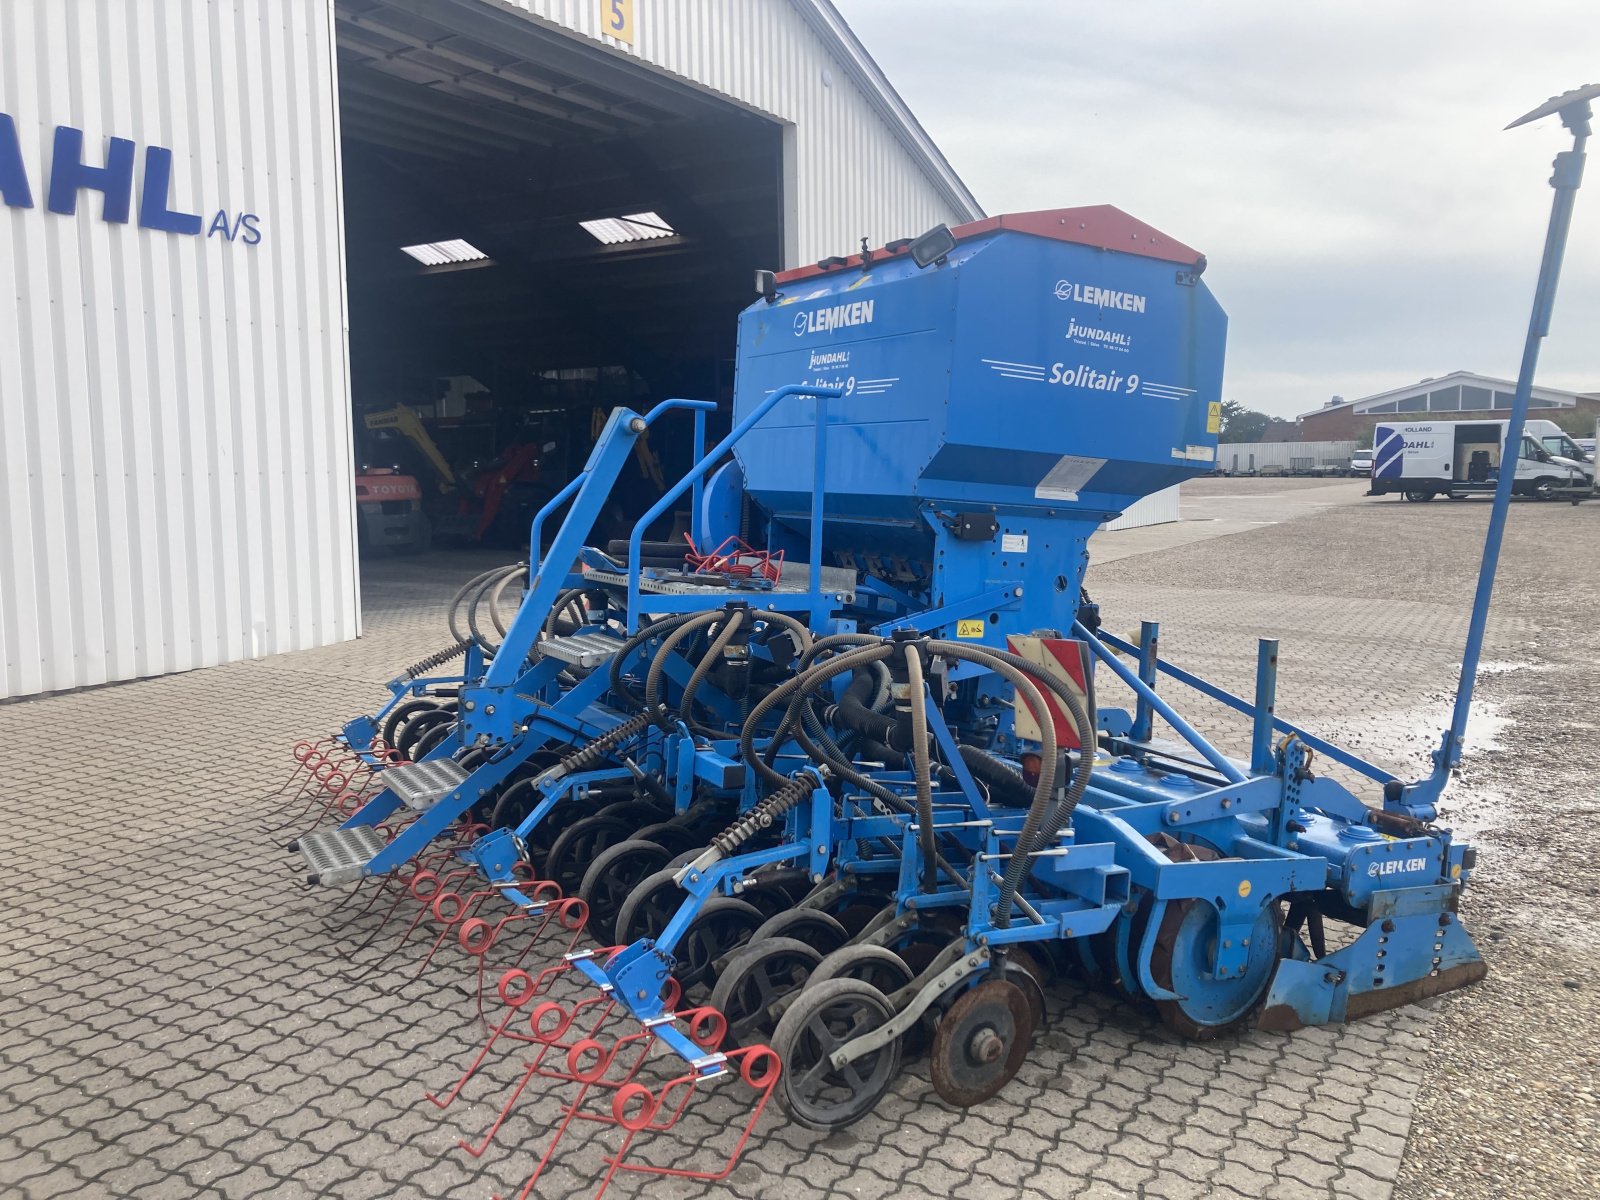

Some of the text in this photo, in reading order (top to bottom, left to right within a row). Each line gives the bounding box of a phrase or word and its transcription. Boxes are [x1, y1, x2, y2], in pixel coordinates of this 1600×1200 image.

[611, 0, 625, 31] 5
[208, 209, 262, 245] A/S
[1073, 283, 1147, 314] LEMKEN
[807, 299, 875, 335] LEMKEN
[845, 376, 855, 396] 9
[1048, 363, 1140, 394] Solitair 9
